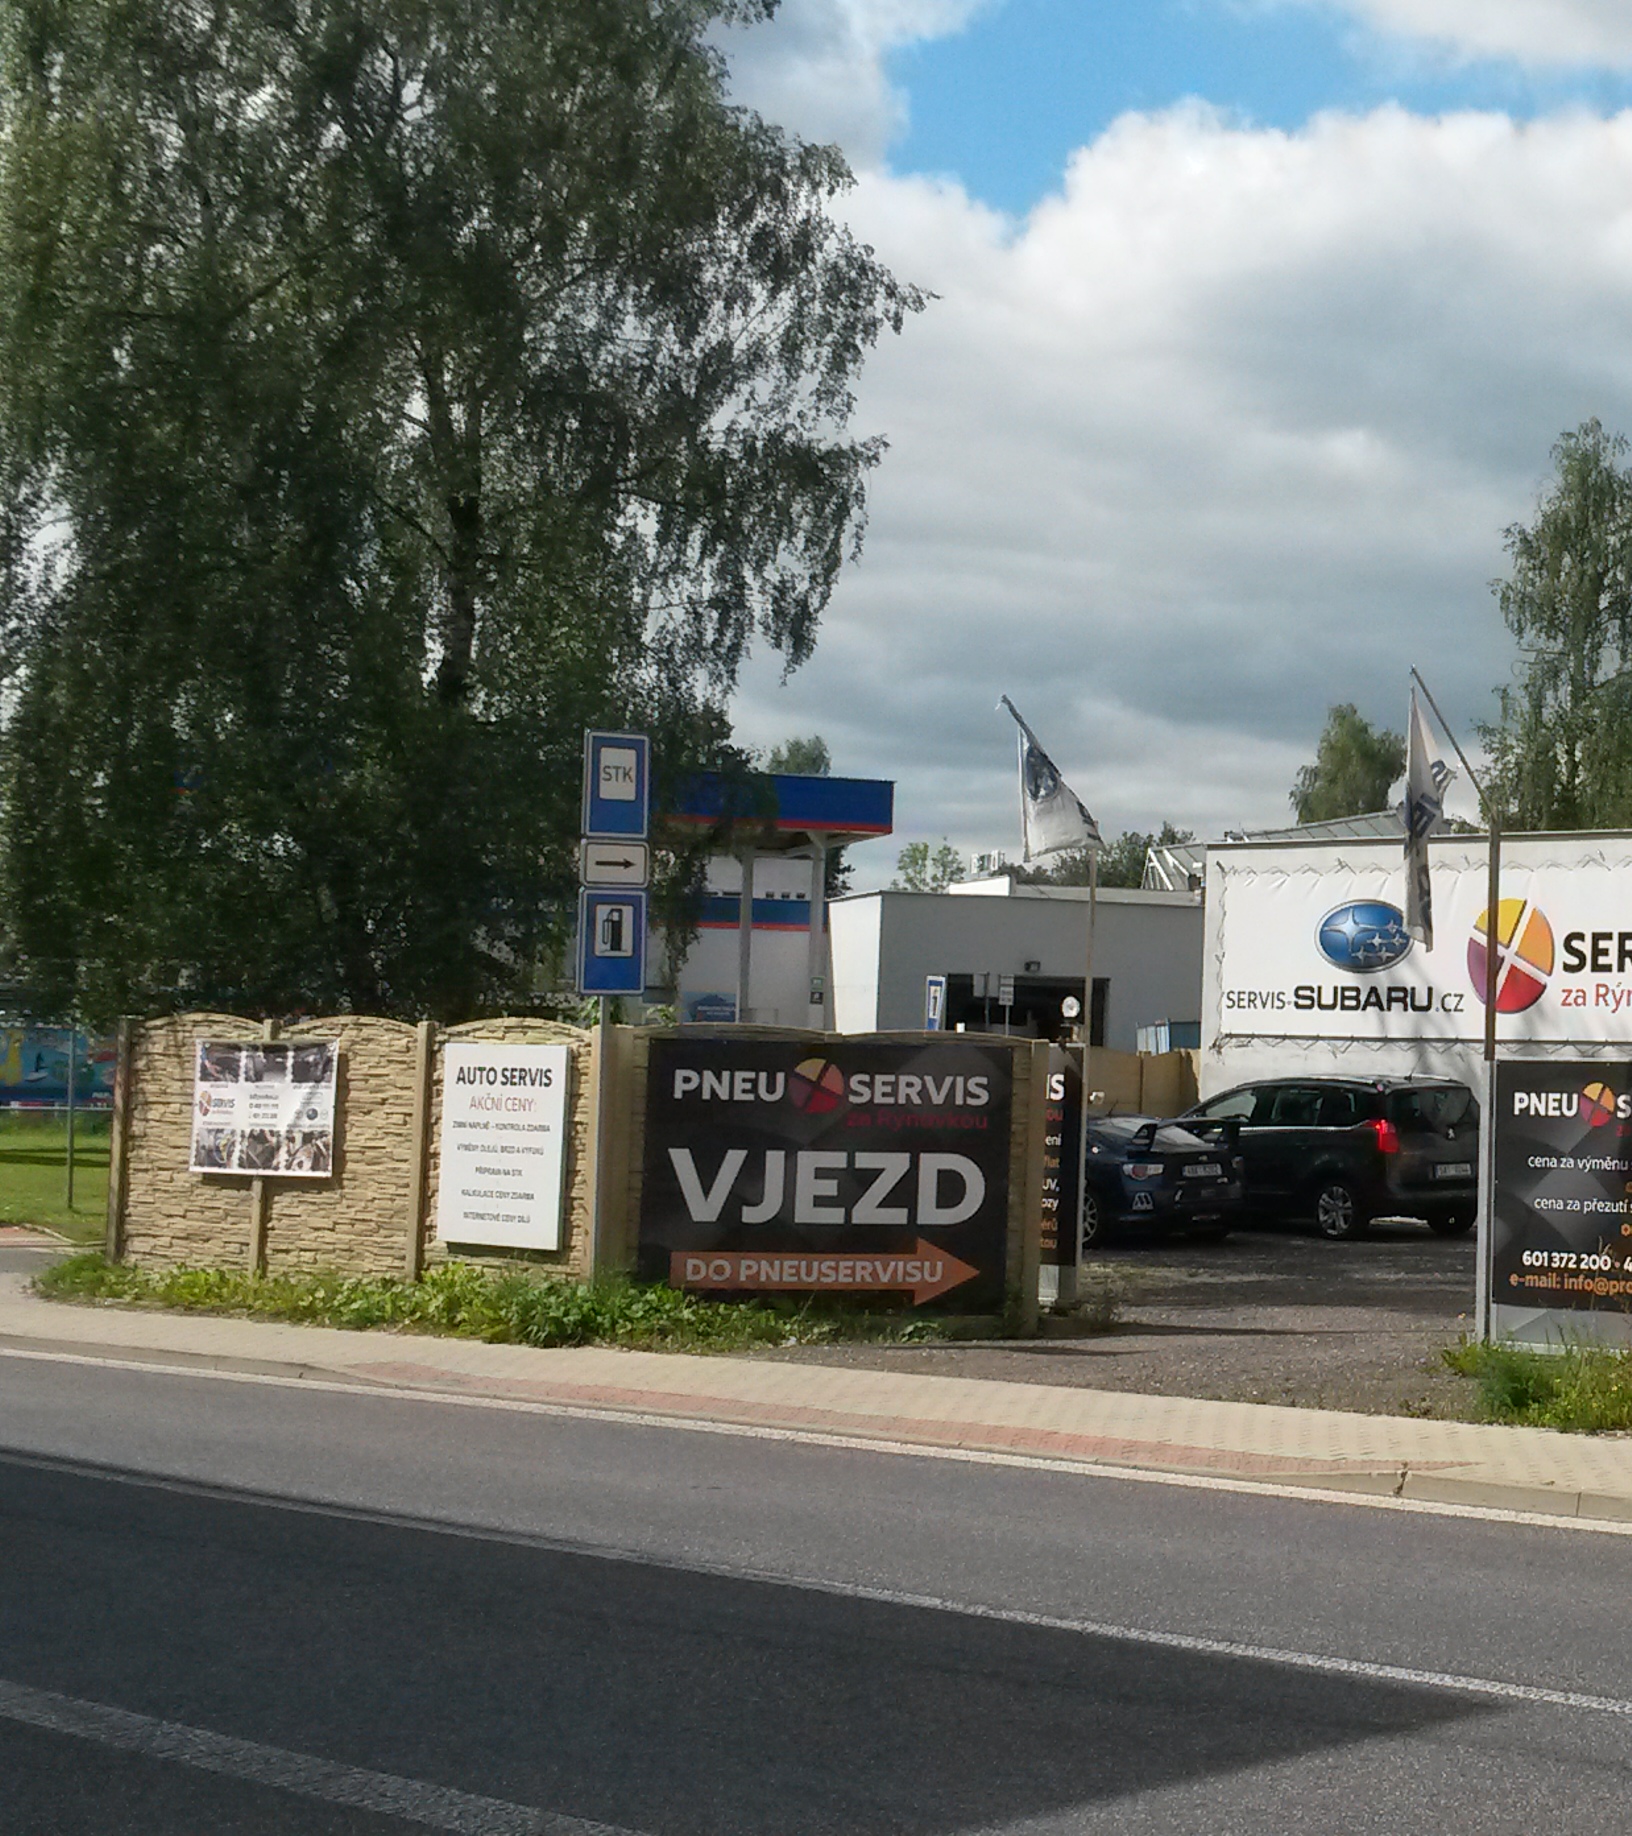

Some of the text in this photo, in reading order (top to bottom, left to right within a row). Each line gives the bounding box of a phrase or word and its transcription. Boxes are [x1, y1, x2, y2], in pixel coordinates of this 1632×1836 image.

[602, 764, 634, 783] STK
[1560, 988, 1587, 1007] za
[455, 1066, 553, 1088] AUTO SERVIS
[673, 1068, 990, 1106] PNEU SERVIS
[1513, 1091, 1579, 1117] PNEU
[847, 1114, 872, 1128] za
[1528, 1155, 1557, 1169] cena
[1559, 1156, 1575, 1169] za
[1577, 1153, 1629, 1172] výměnu
[667, 1147, 986, 1226] VJEZD
[1533, 1198, 1564, 1211] cena
[1566, 1199, 1581, 1211] za
[1583, 1197, 1628, 1215] přezutí
[1521, 1250, 1549, 1267] 601
[1550, 1252, 1577, 1268] 372
[1579, 1253, 1612, 1271] 200
[685, 1258, 944, 1284] DO PNEUSERVISU
[1509, 1272, 1561, 1289] e-mail:
